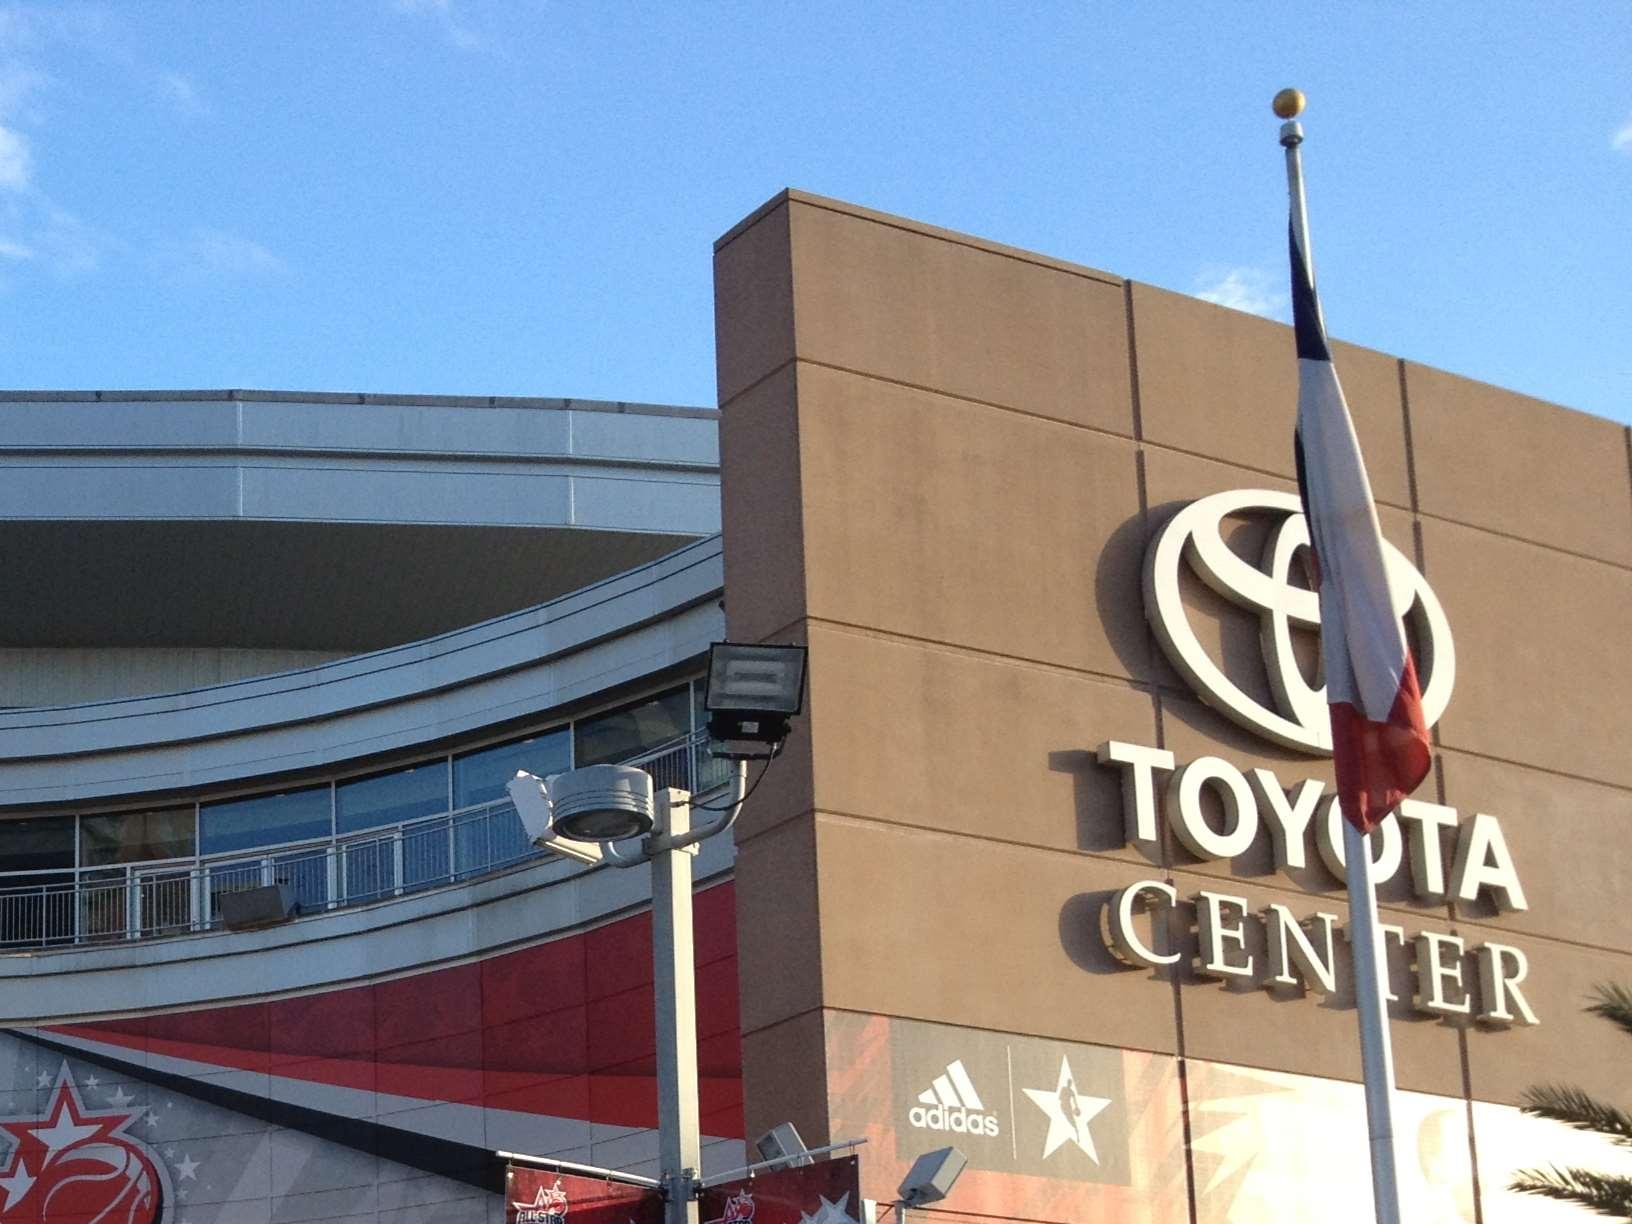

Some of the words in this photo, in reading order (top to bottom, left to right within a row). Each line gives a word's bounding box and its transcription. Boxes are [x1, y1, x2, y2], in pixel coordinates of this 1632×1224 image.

[1104, 740, 1528, 912] TOYOTA
[1107, 880, 1539, 1025] CENTER
[909, 1104, 1000, 1137] adidas
